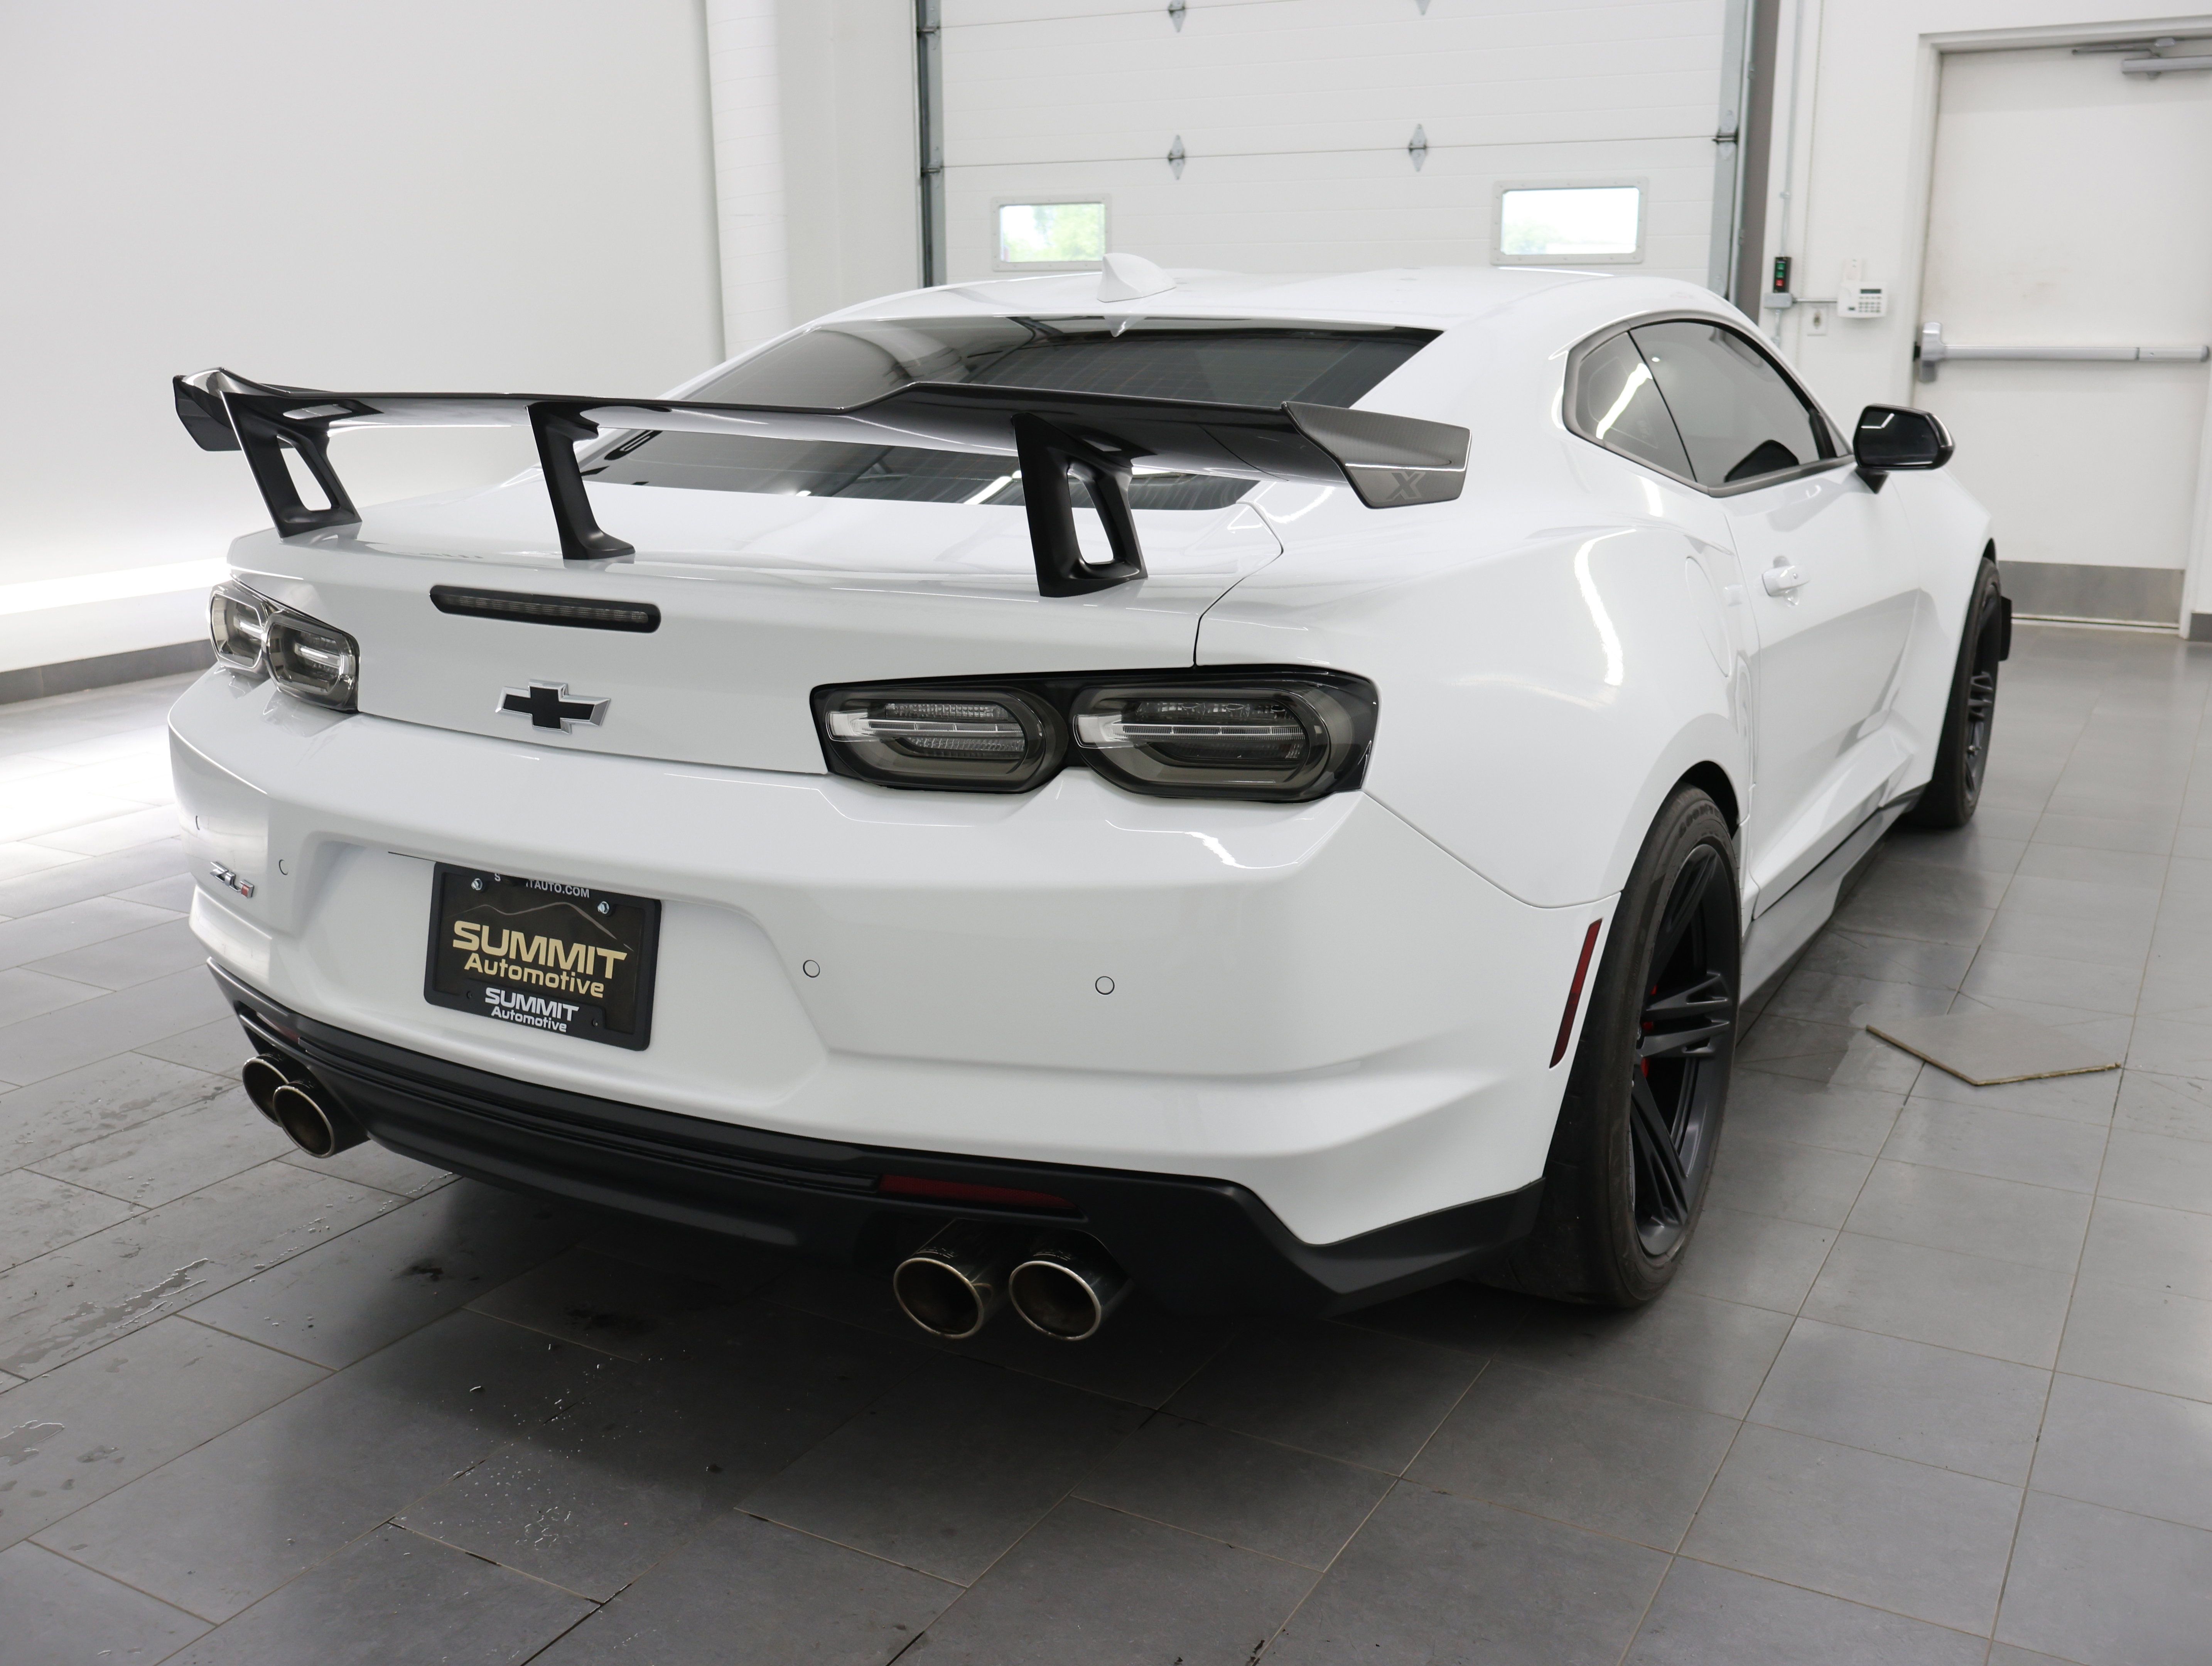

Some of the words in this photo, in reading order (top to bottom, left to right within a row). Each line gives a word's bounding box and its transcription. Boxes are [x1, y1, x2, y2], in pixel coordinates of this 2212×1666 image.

[1385, 471, 1426, 501] X
[210, 861, 255, 899] ZL1
[494, 873, 590, 898] SITAUTO.COM
[452, 920, 628, 979] SUMMIT
[464, 952, 604, 998] Automotive
[484, 986, 580, 1022] SUMMIT
[491, 1006, 568, 1033] Automotive
